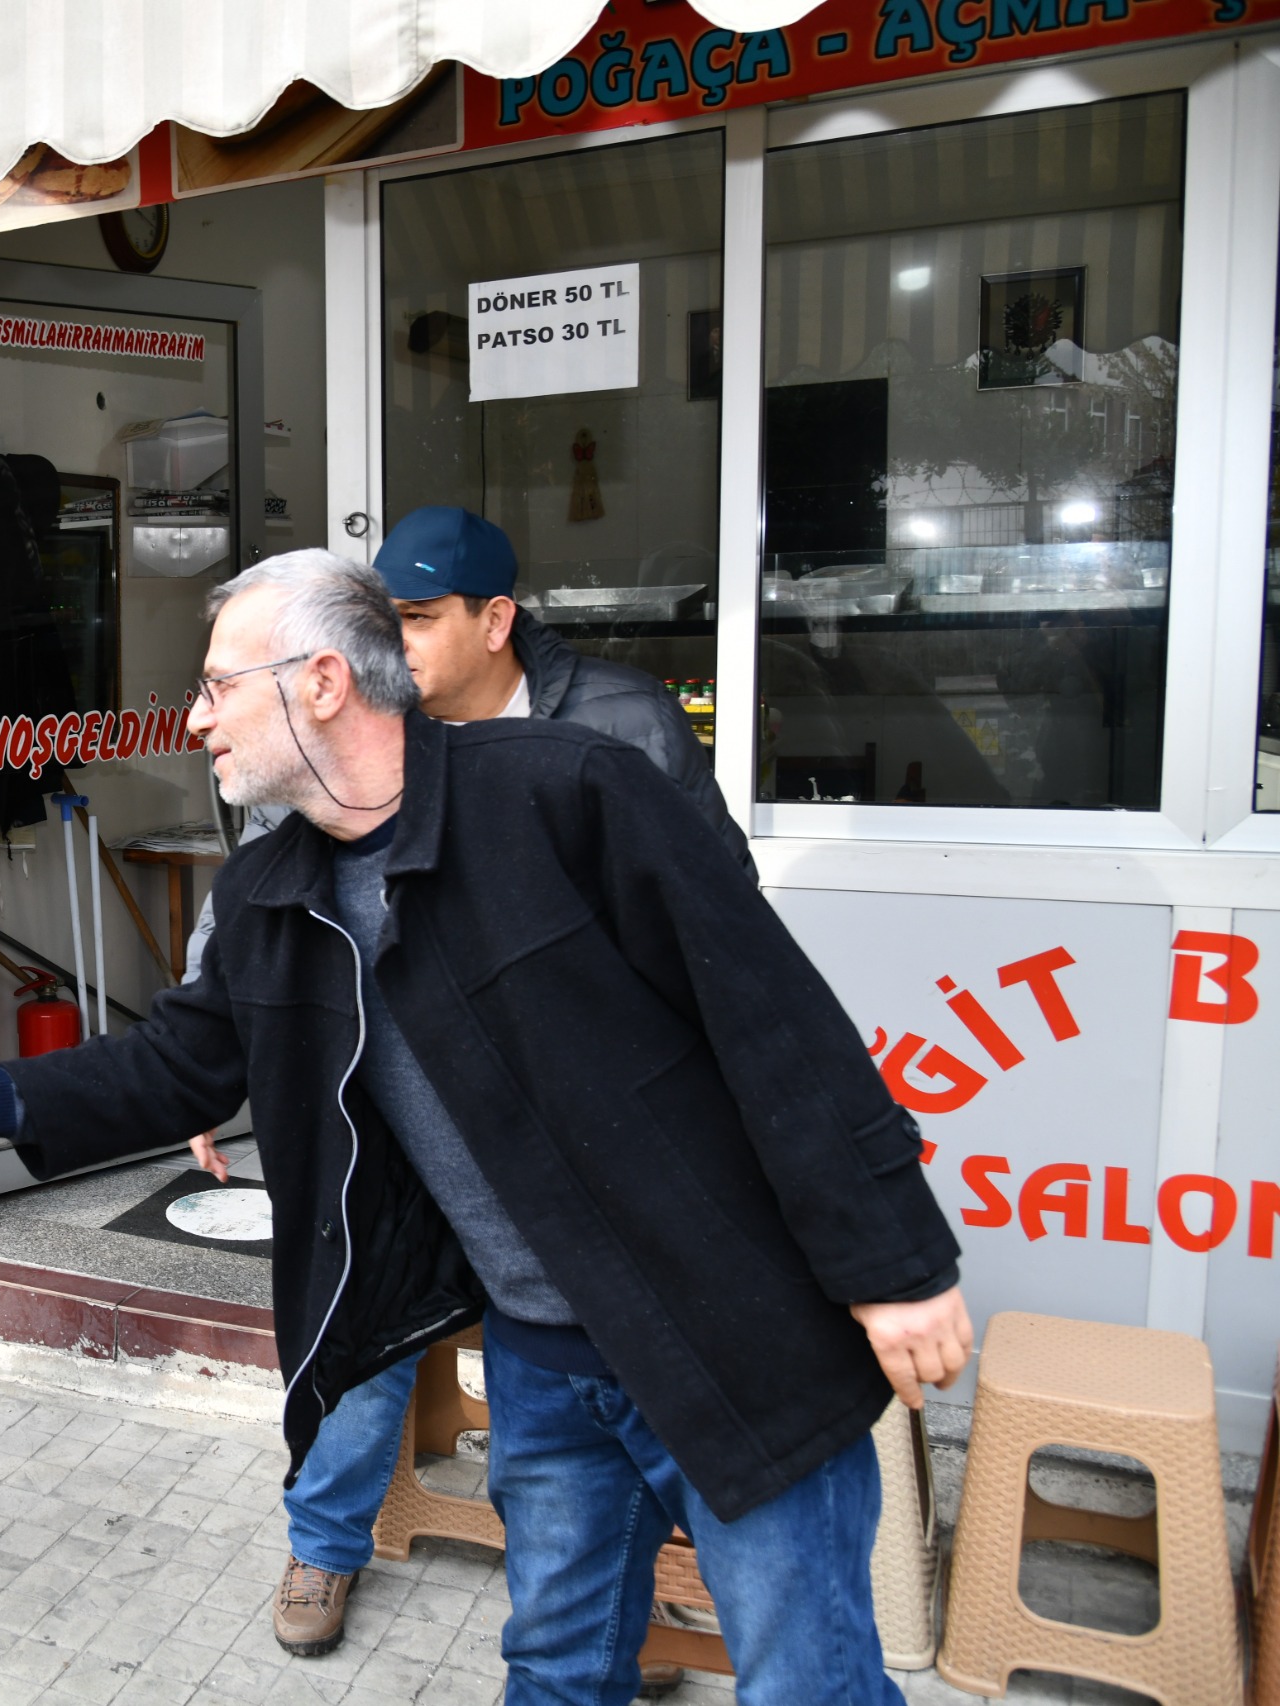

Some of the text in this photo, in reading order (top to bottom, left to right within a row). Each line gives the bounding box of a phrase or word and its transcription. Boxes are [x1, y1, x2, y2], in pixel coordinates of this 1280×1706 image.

[498, 28, 791, 127] POĞAÇA
[477, 280, 630, 314] DÖNER 50 TL
[477, 318, 627, 350] PATSO 30 TL
